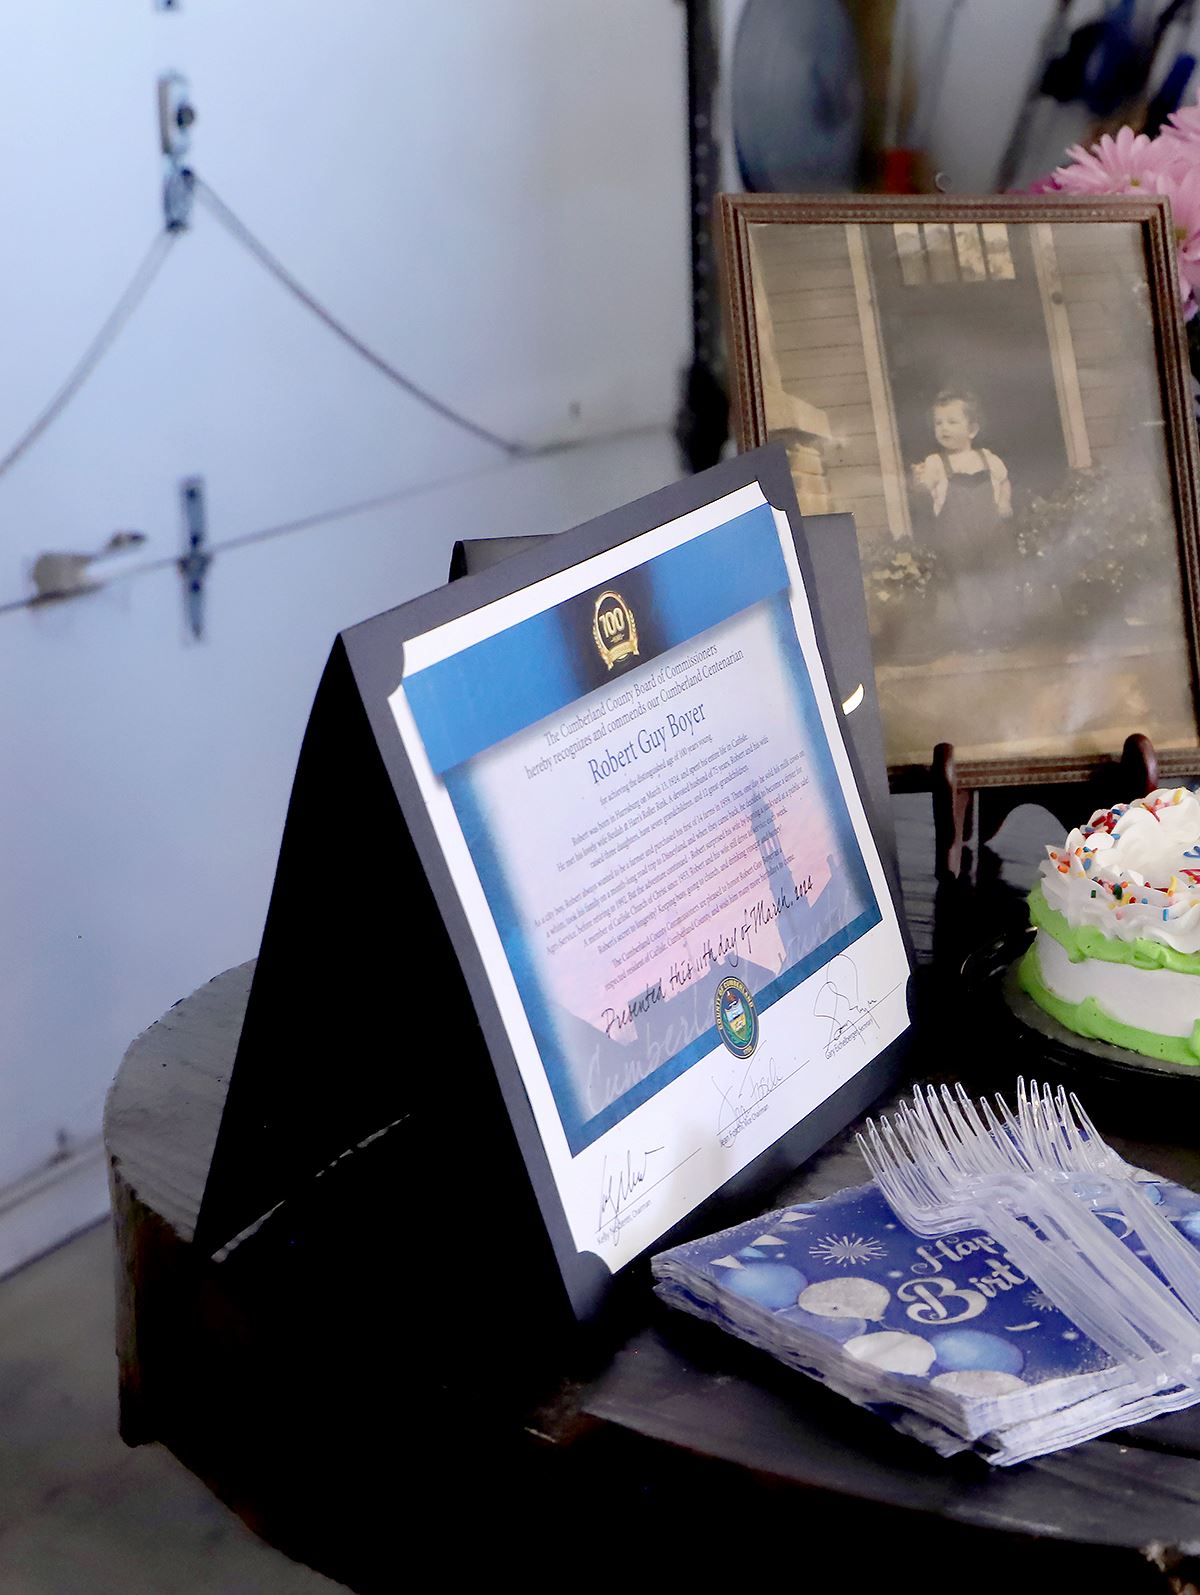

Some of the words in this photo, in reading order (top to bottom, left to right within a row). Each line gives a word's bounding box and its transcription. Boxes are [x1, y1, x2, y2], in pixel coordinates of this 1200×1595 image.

[599, 607, 625, 638] 100
[524, 757, 552, 780] hereby
[553, 735, 592, 764] recognizes
[593, 722, 607, 741] and
[607, 702, 646, 732] commends
[647, 696, 660, 710] our
[660, 669, 702, 702] Cumberland
[702, 650, 744, 678] Centenarian
[544, 731, 560, 746] The
[560, 702, 606, 737] Cumberland
[606, 690, 634, 712] County
[634, 674, 656, 696] Board
[657, 668, 666, 684] of
[665, 645, 717, 679] Commissioners
[588, 742, 637, 784] Robert
[638, 726, 666, 754] Guy
[666, 704, 705, 738] Boyer
[601, 978, 666, 1037] Presented
[670, 961, 693, 990] this
[718, 928, 739, 967] day
[741, 909, 752, 954] of
[897, 1258, 1029, 1325] Birt
[911, 1236, 1001, 1275] Hap
